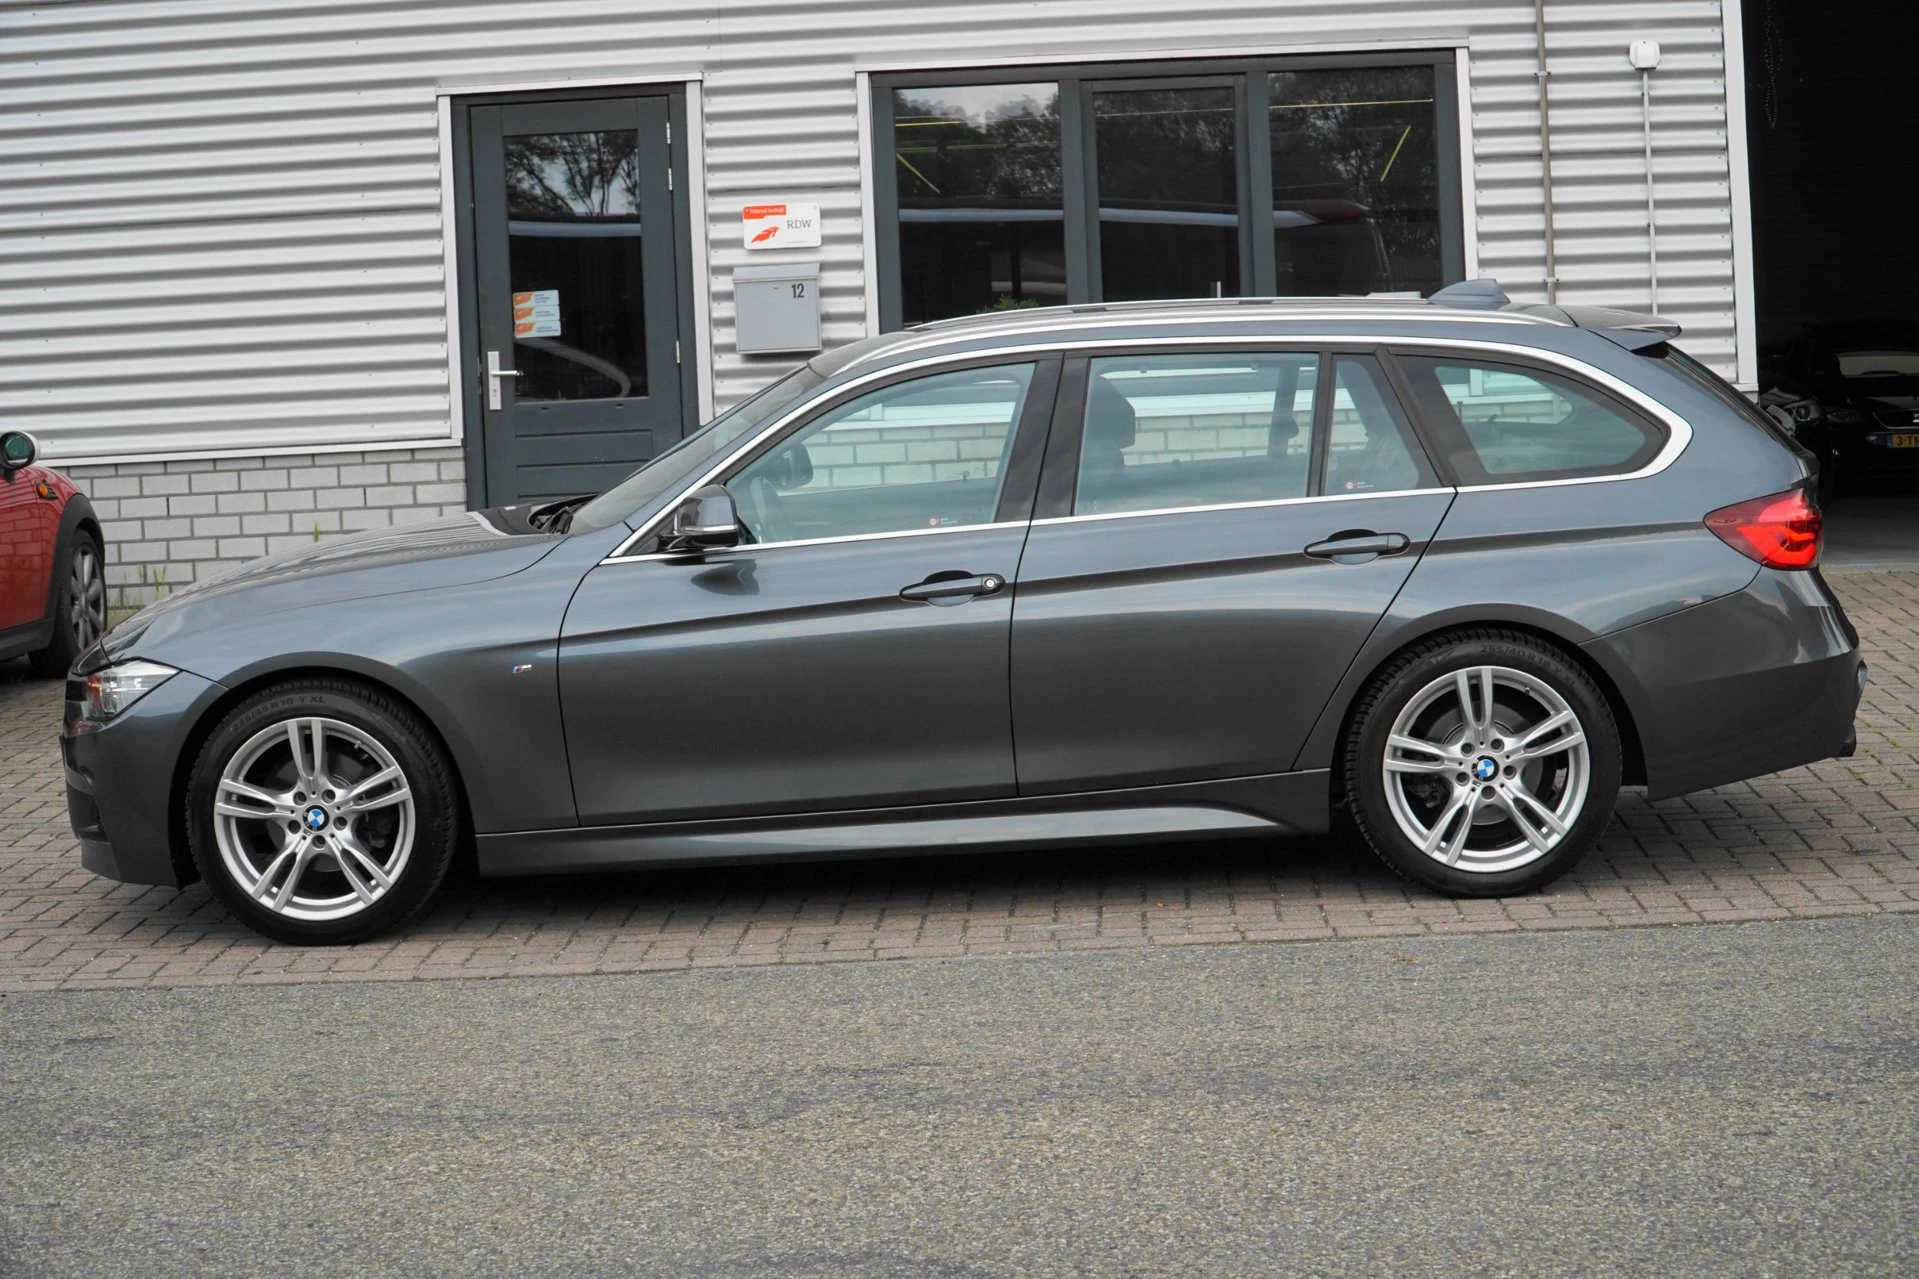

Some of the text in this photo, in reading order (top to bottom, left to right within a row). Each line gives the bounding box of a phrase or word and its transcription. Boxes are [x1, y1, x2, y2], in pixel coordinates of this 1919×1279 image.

[787, 219, 812, 229] RDW
[791, 283, 805, 298] 12
[1479, 645, 1525, 657] 255/40
[281, 697, 294, 706] 18
[310, 695, 326, 704] XL
